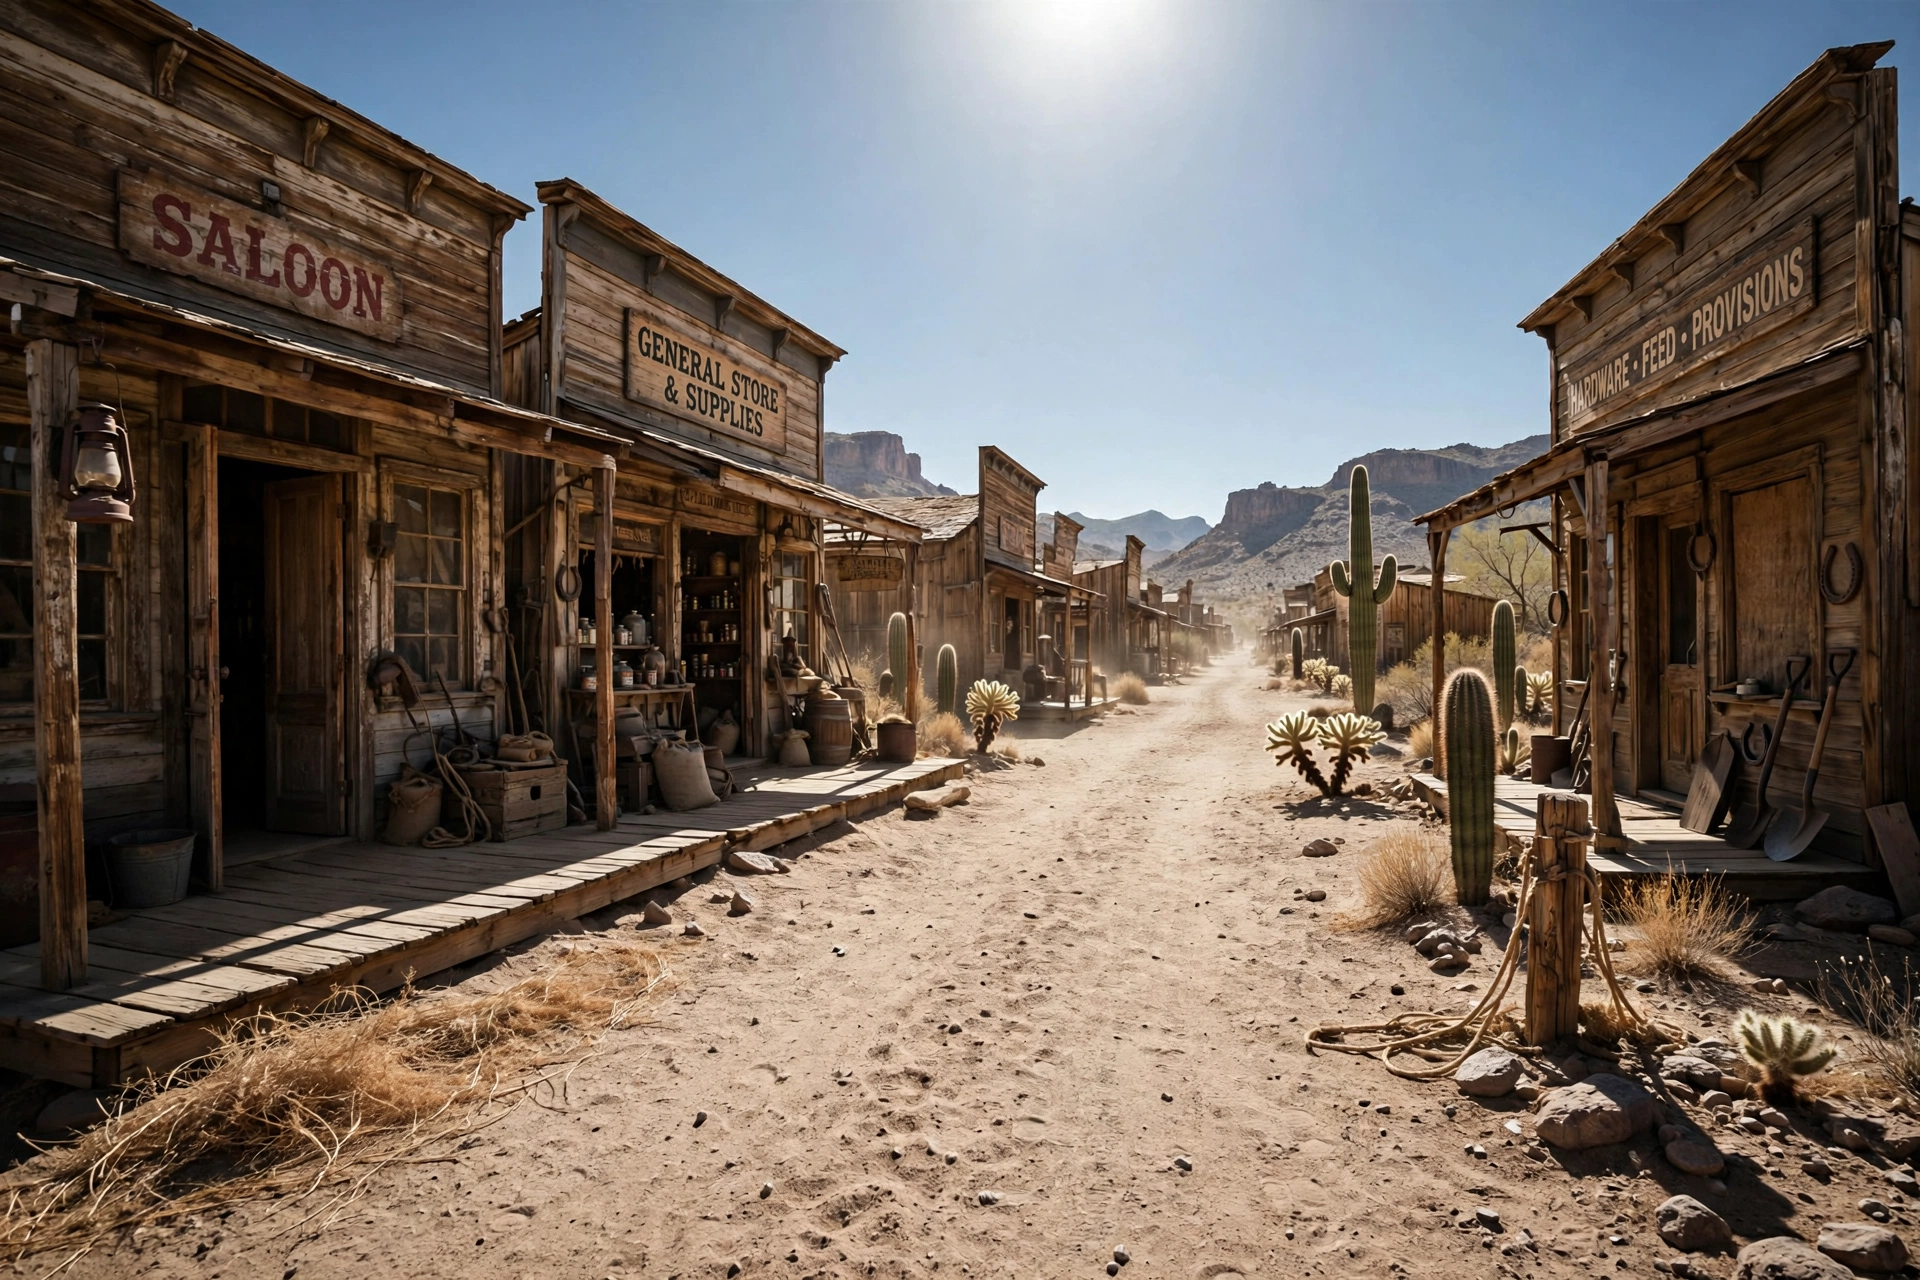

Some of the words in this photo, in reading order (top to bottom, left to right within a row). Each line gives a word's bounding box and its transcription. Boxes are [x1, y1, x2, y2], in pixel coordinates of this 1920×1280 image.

[152, 193, 384, 322] SALOON
[637, 326, 725, 391] GENERAL
[731, 370, 779, 414] STORE
[1570, 352, 1629, 416] HARDWARE
[1642, 326, 1676, 378] FEED
[1692, 247, 1804, 350] PROVISIONS
[664, 375, 679, 405] &
[686, 382, 763, 437] SUPPLIES
